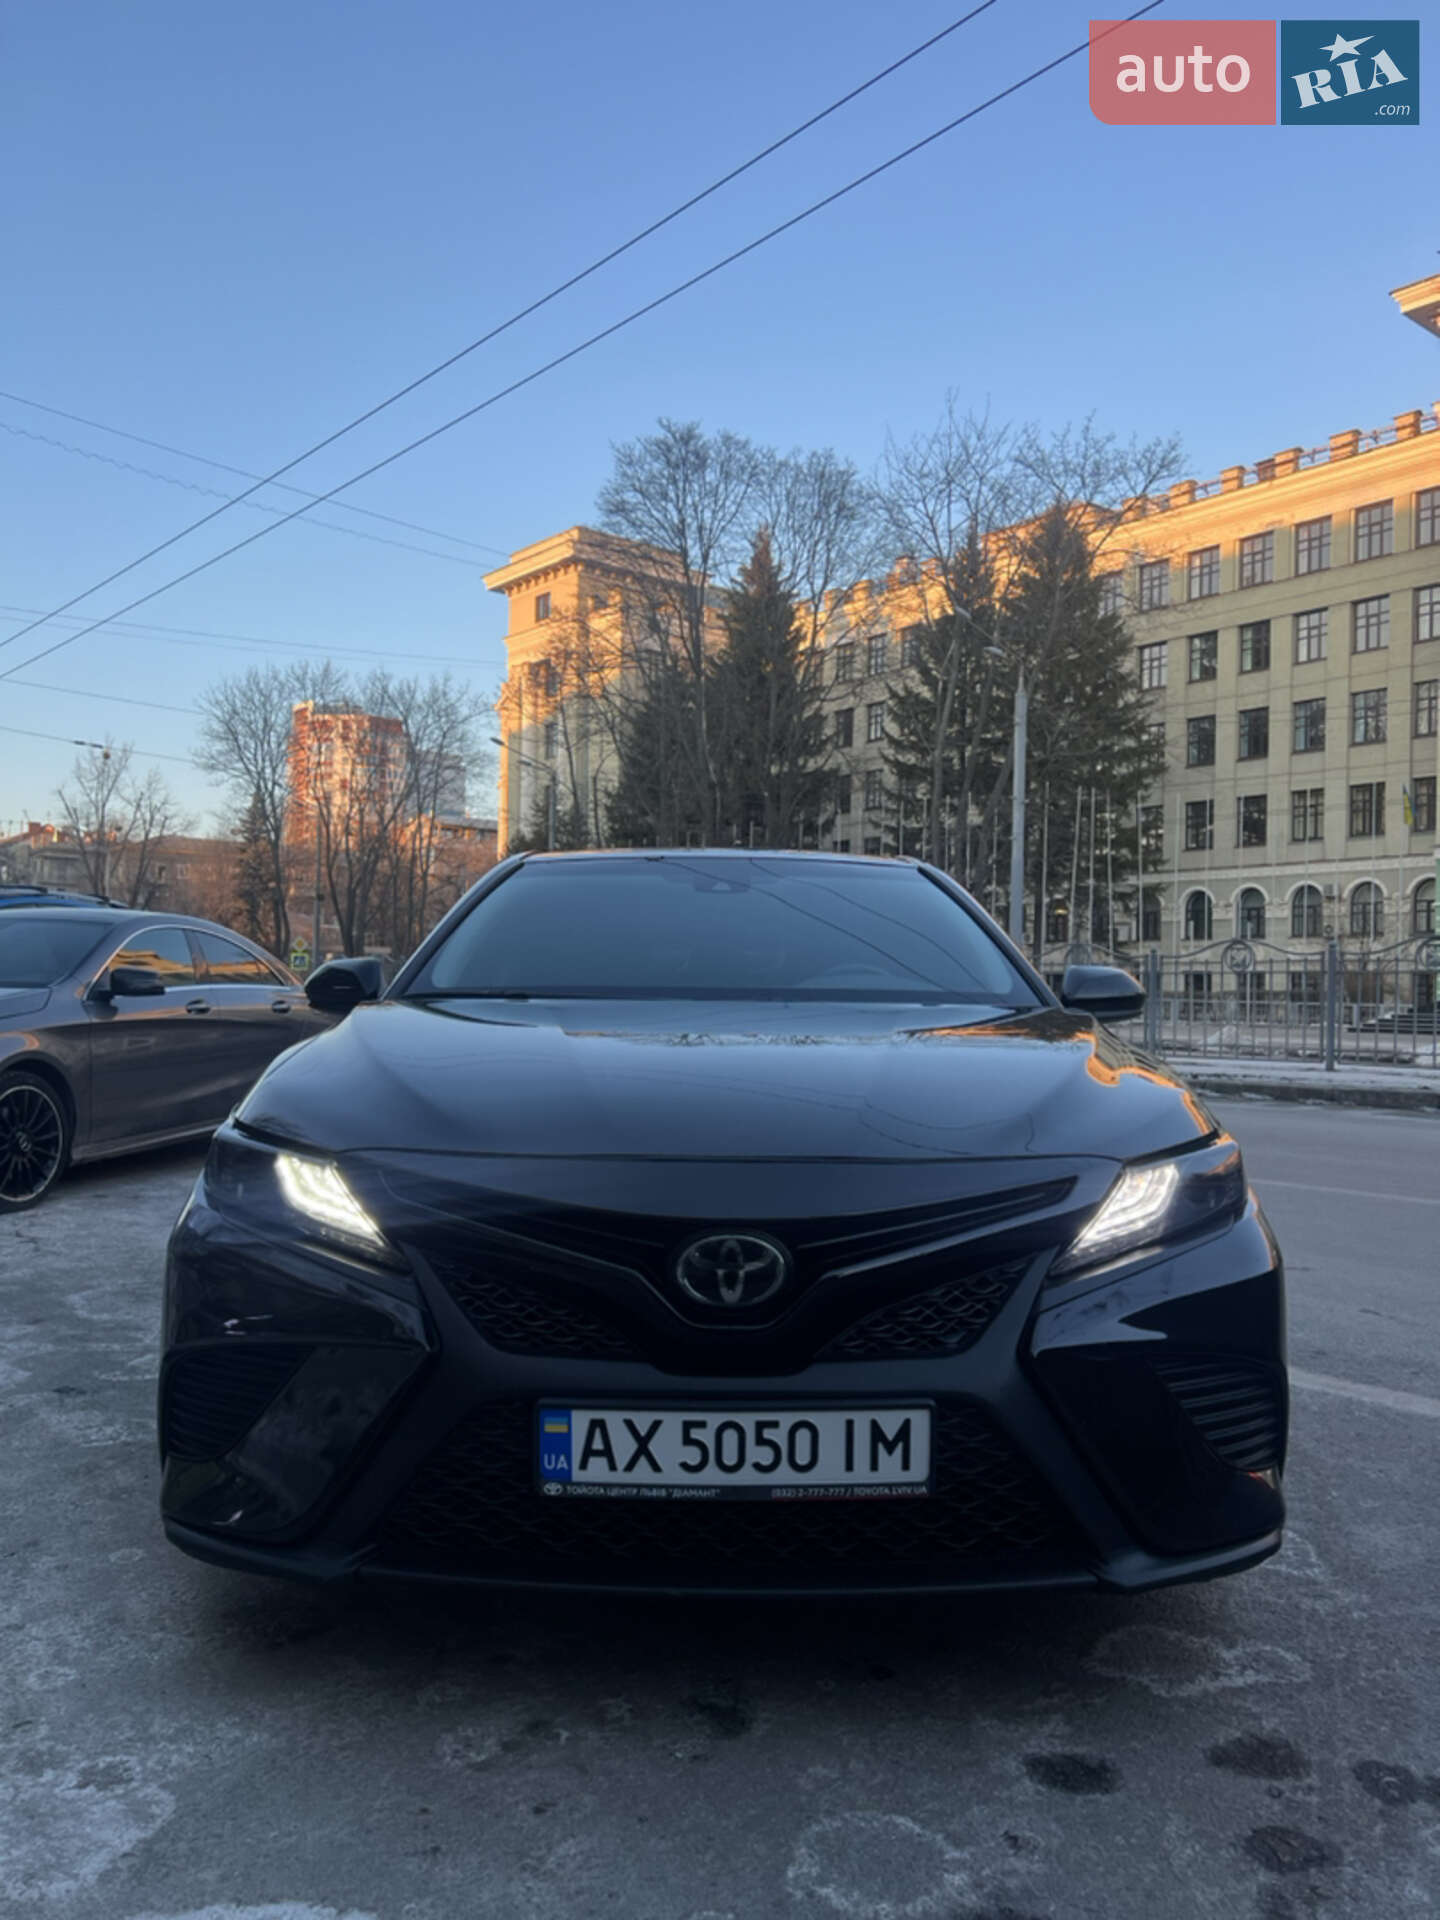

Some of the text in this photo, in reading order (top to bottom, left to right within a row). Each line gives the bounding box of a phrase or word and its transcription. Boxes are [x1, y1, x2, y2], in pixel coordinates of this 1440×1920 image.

[543, 1454, 569, 1471] UA
[578, 1418, 912, 1474] AX 5050 IM
